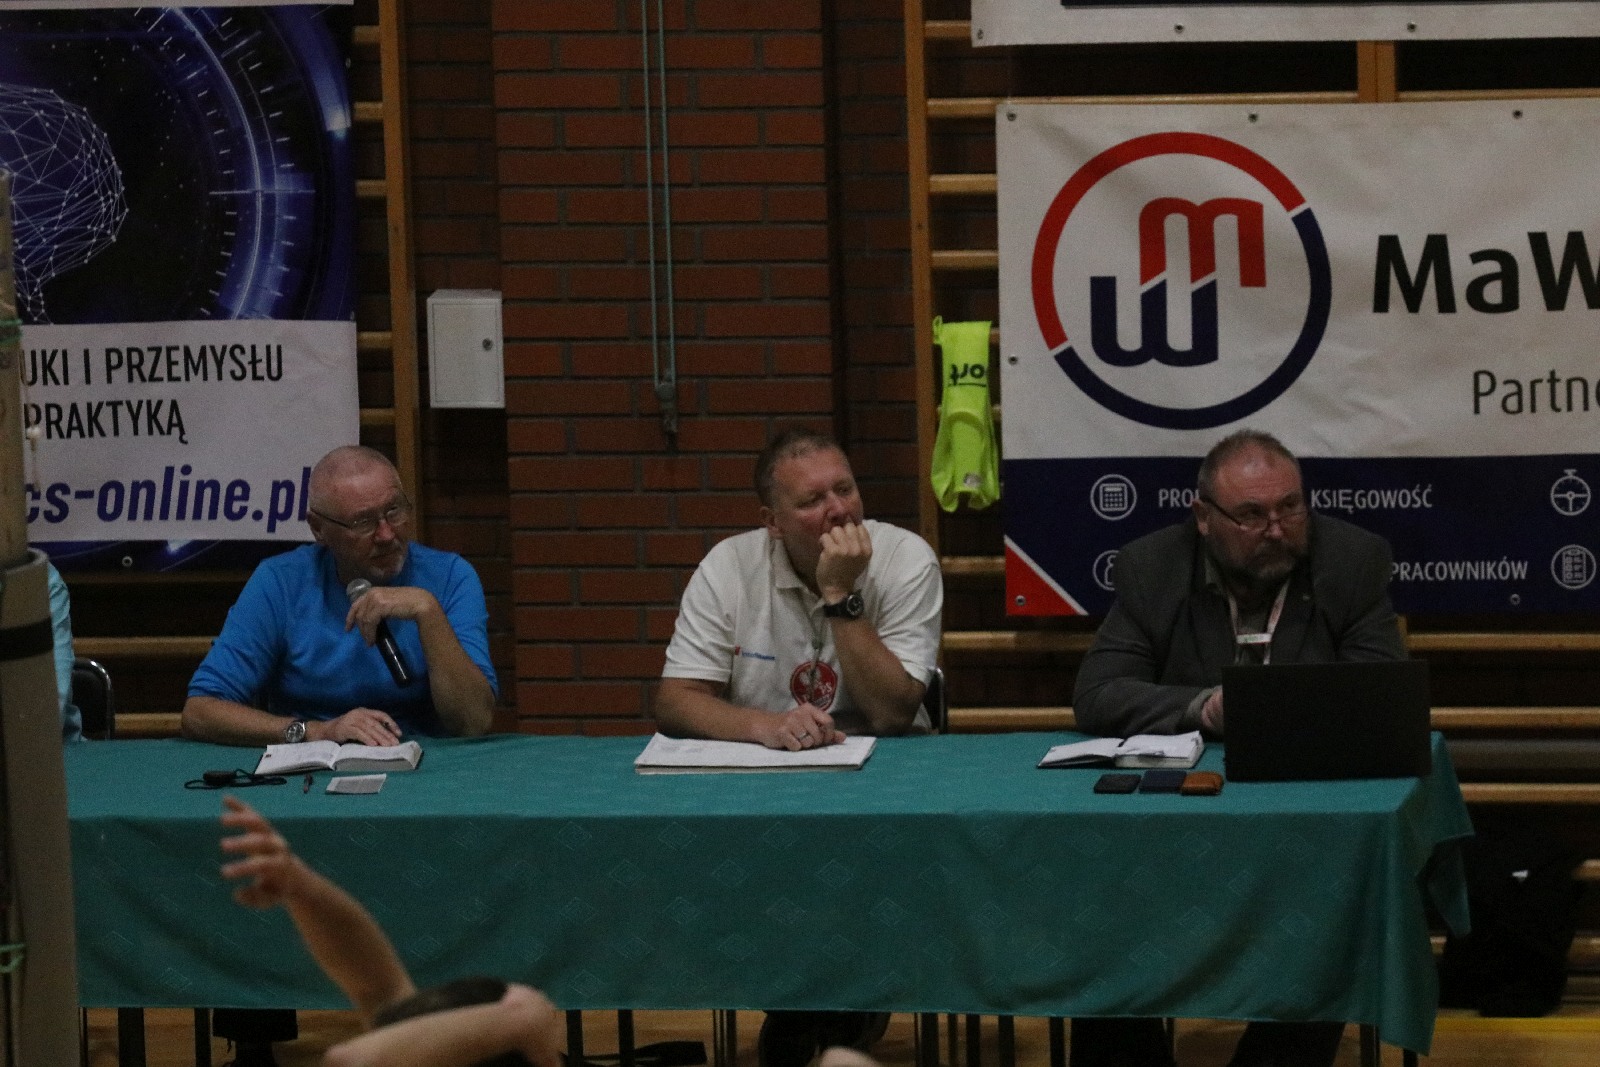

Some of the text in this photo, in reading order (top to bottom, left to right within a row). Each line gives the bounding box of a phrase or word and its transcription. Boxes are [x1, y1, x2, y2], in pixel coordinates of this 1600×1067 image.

[83, 348, 92, 385] I
[105, 344, 283, 384] PRZEMYSŁU
[1472, 369, 1600, 415] Partn
[24, 399, 188, 444] PRAKTYKĄ
[1311, 484, 1433, 514] KSIĘGOWOŚĆ
[1390, 556, 1528, 581] PRACOWNIKÓW
